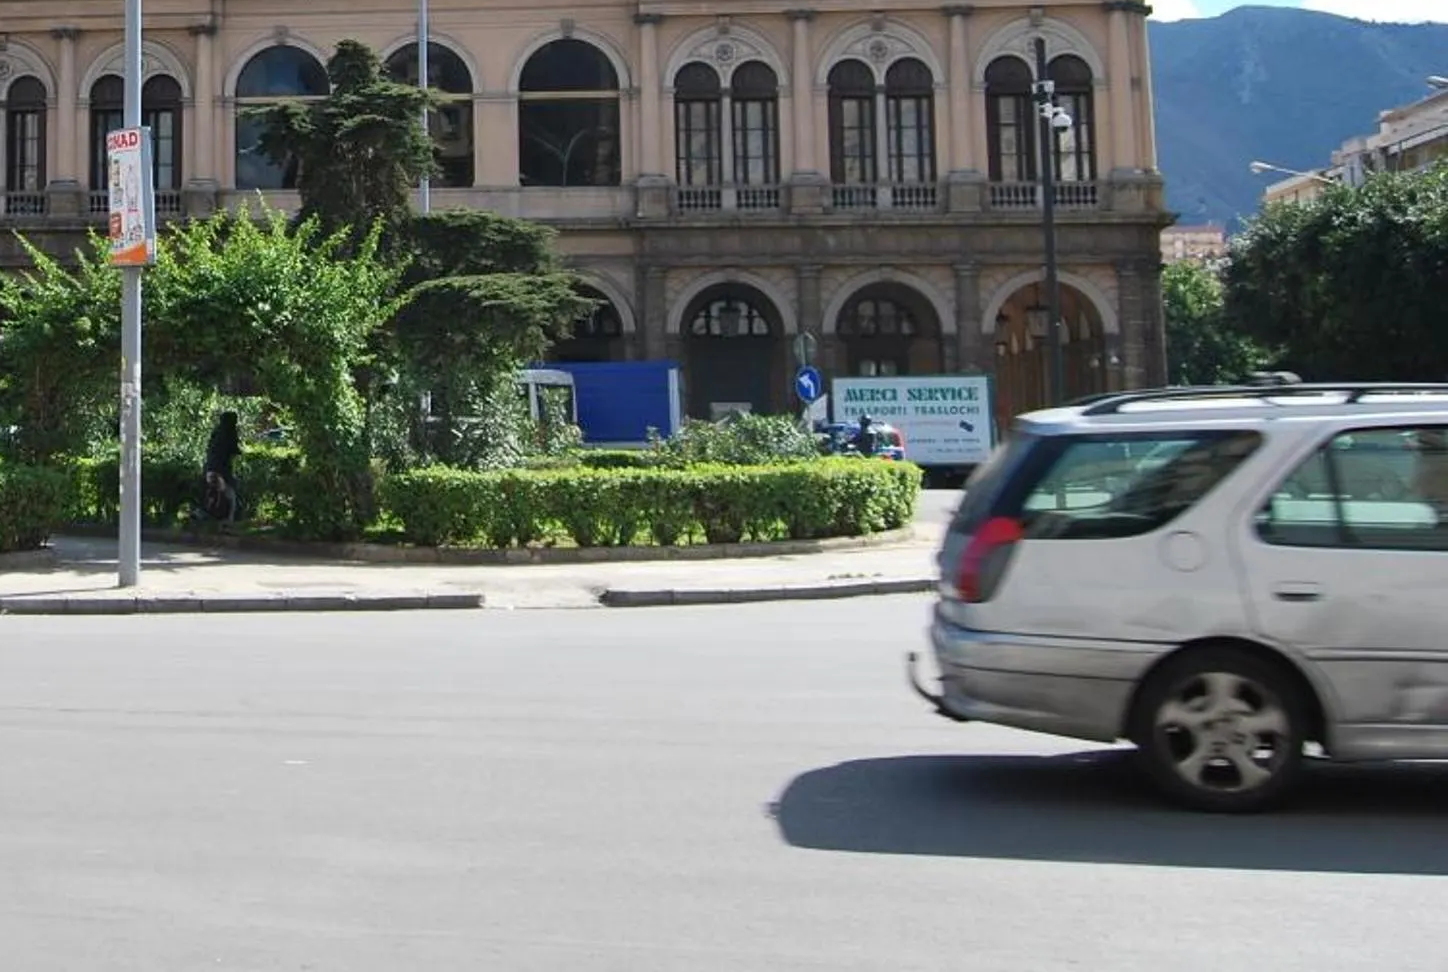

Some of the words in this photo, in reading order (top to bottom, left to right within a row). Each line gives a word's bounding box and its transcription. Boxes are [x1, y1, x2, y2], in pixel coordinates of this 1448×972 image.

[844, 388, 897, 401] MERCI
[907, 386, 979, 401] SERVICE
[844, 405, 907, 416] TRASPORTI
[915, 405, 980, 415] TRASLOCHI
